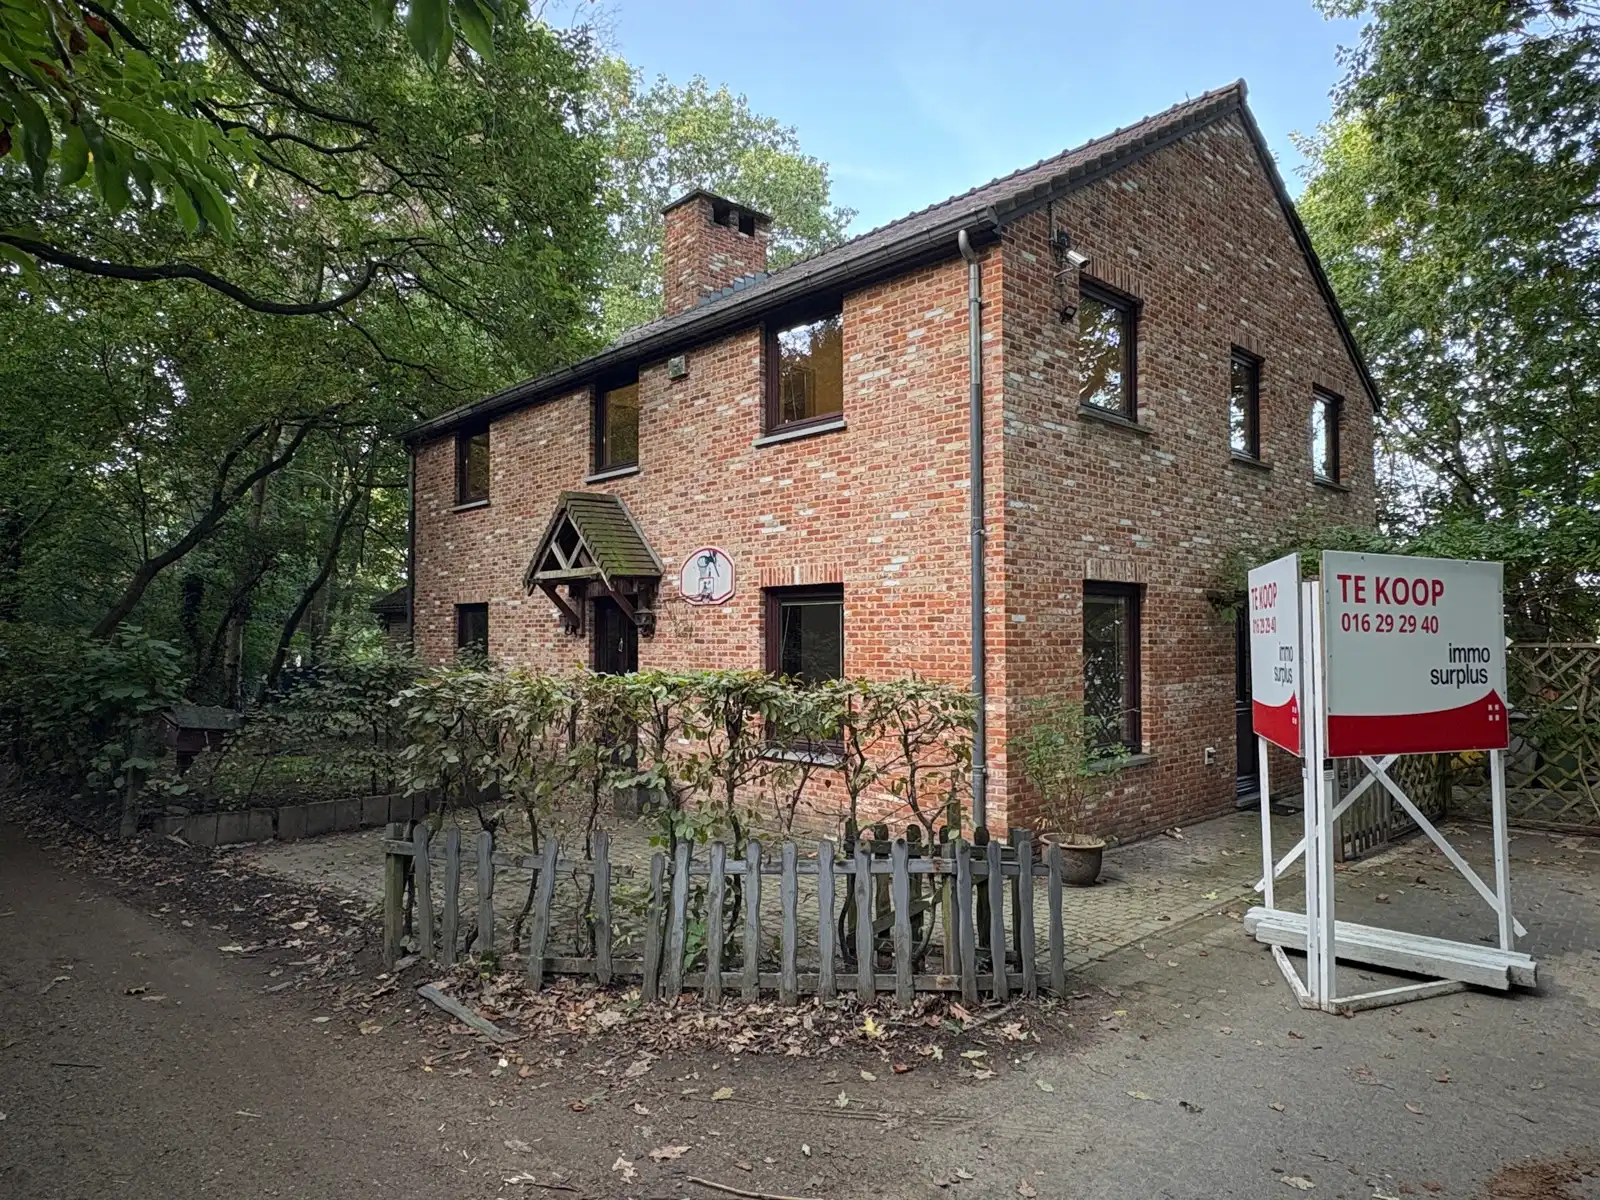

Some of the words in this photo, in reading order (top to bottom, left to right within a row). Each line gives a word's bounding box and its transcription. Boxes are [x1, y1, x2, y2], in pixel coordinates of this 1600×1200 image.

[1251, 587, 1258, 610] TE
[1259, 582, 1277, 609] KOOP
[1337, 574, 1366, 603] TE
[1375, 576, 1444, 606] KOOP
[1341, 612, 1371, 632] 016
[1375, 613, 1394, 633] 29
[1398, 614, 1417, 633] 29
[1421, 615, 1439, 634] 40
[1279, 642, 1293, 661] immo
[1448, 642, 1491, 663] immo
[1274, 663, 1293, 687] surplus
[1430, 663, 1488, 689] surplus
